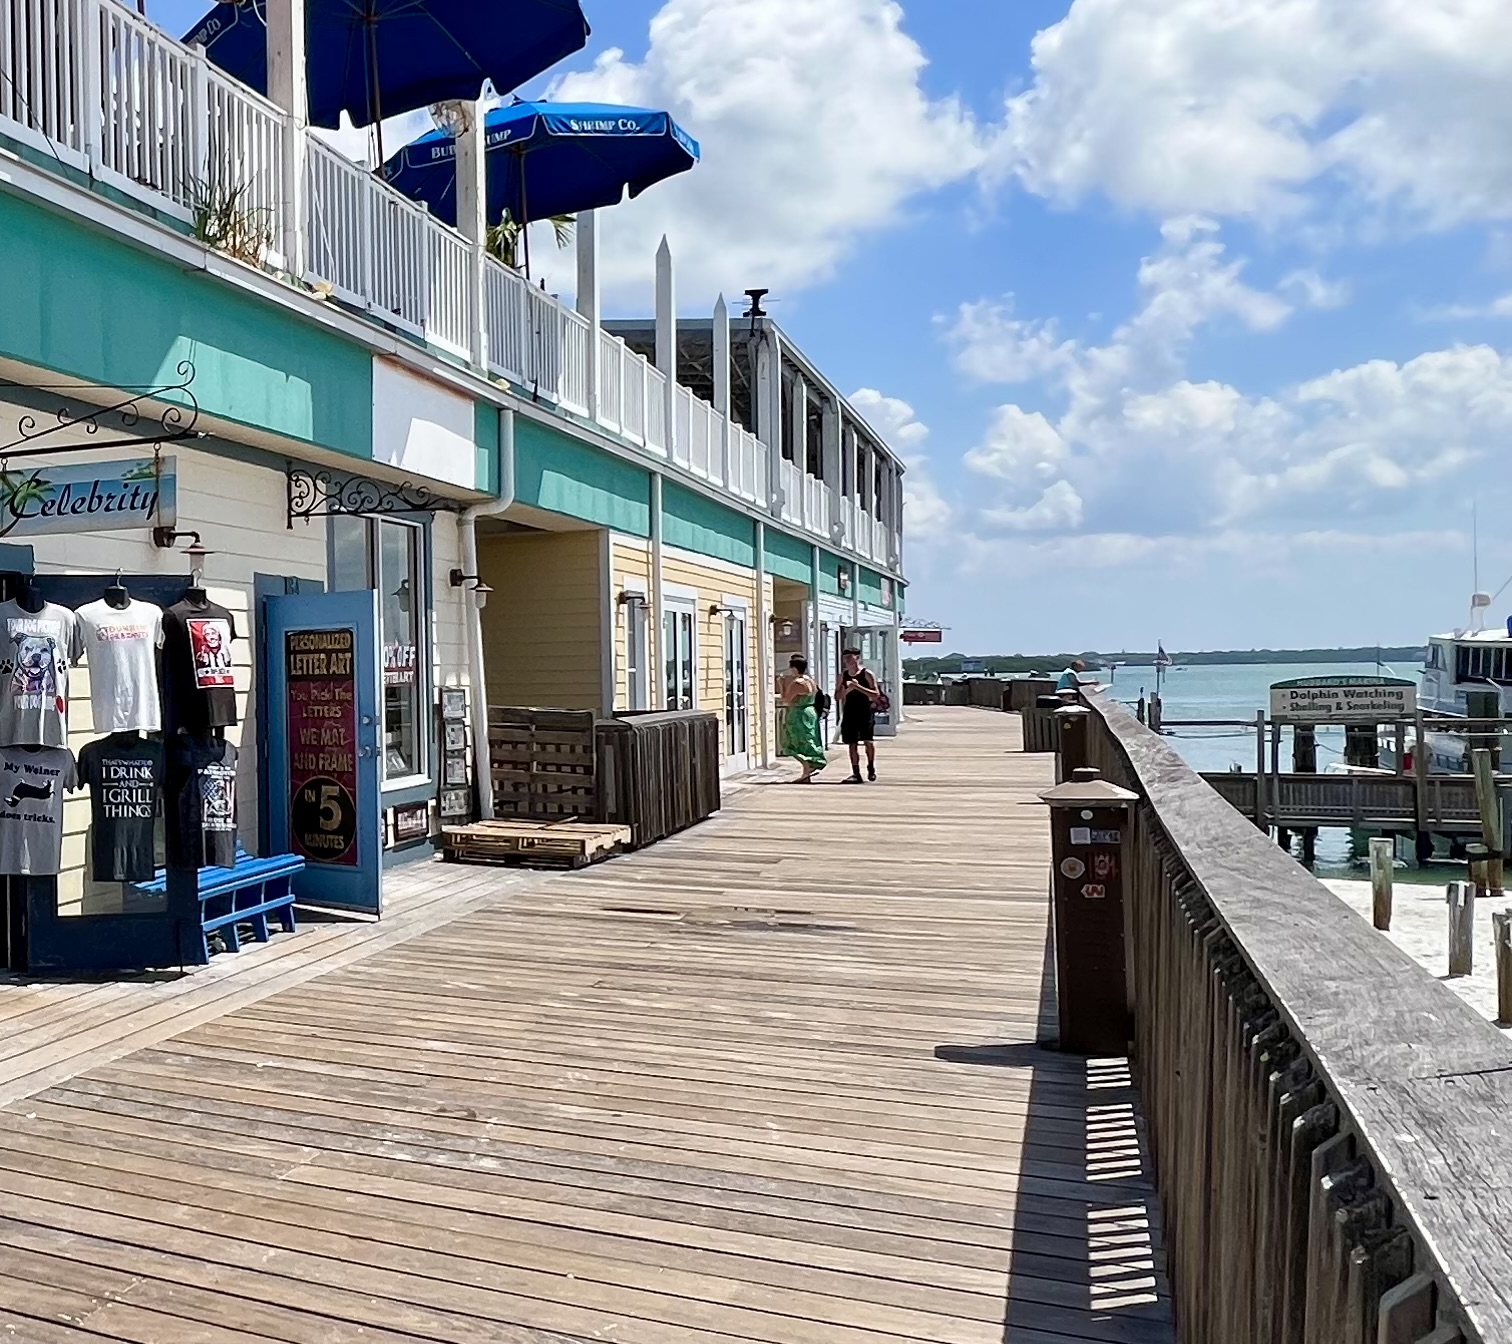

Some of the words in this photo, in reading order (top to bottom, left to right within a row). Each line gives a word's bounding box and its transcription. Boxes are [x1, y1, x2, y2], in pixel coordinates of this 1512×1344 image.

[571, 118, 615, 131] SHRIMP
[9, 478, 159, 521] Celebrity
[290, 633, 351, 650] PERSONALIZED
[291, 654, 327, 675] LETTER
[329, 653, 351, 675] ART
[1290, 689, 1339, 700] Dolphin
[1343, 689, 1404, 700] Watching
[303, 706, 341, 718] LETTERS
[1290, 702, 1332, 713] Shelling
[1336, 702, 1343, 711] &
[1347, 701, 1405, 712] Snorkeling
[300, 727, 318, 745] WE
[4, 762, 19, 773] My
[24, 765, 61, 777] Weiner
[294, 752, 316, 770] AND
[318, 753, 353, 772] FRAME
[110, 767, 153, 779] DRINK
[109, 788, 153, 803] GRILL
[103, 804, 152, 817] THINGS
[304, 789, 316, 802] IN
[319, 785, 342, 832] 5
[0, 810, 21, 821] does
[24, 813, 55, 824] tricks.
[304, 835, 345, 850] MINUTES
